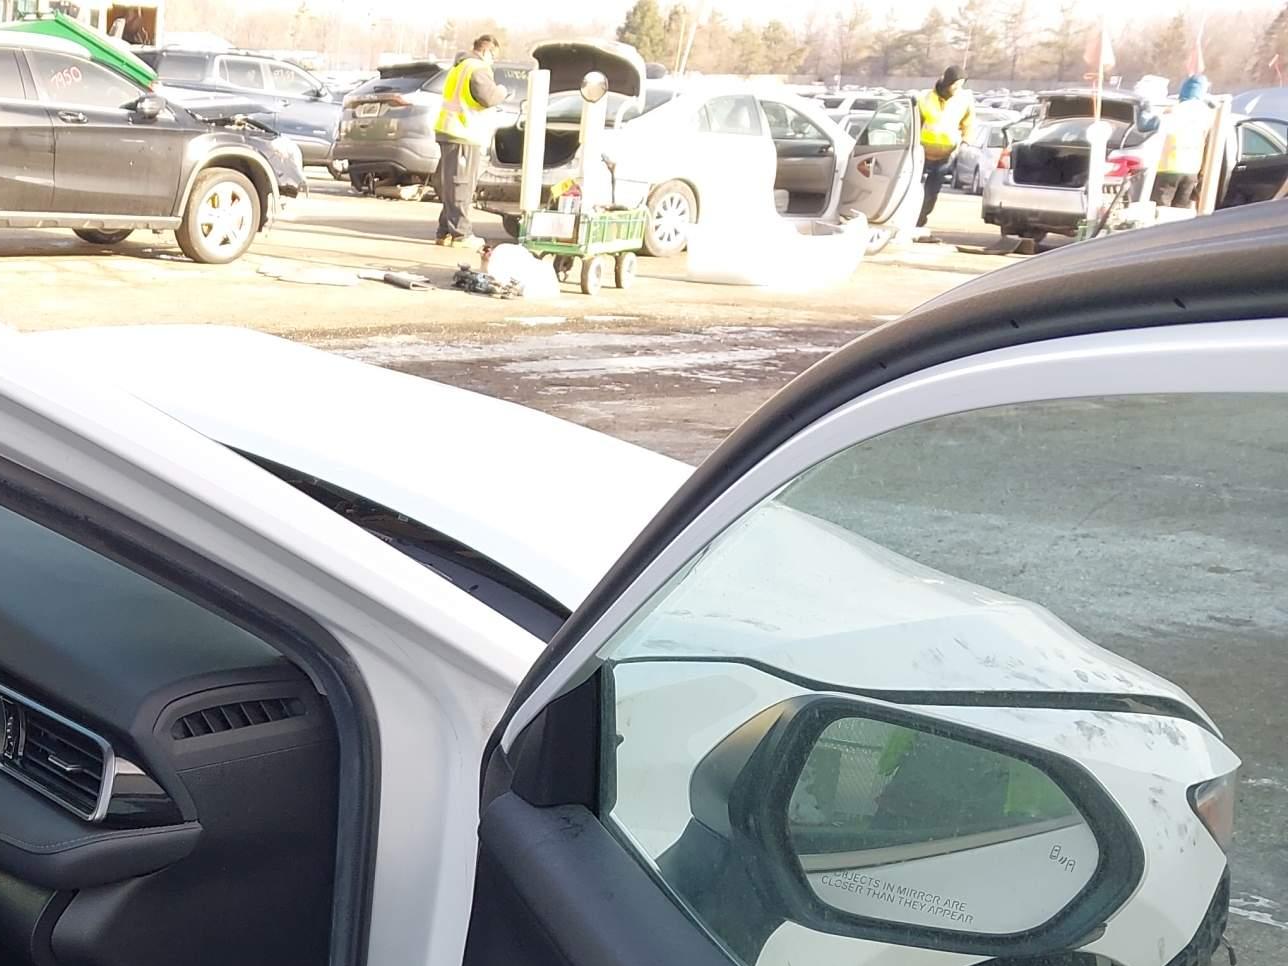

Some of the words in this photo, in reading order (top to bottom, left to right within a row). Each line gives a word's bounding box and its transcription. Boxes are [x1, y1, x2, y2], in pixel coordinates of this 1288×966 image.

[821, 875, 864, 895] CLOSER
[866, 887, 895, 904] THAN
[898, 896, 926, 912] THEY
[927, 905, 974, 924] APPEAR
[883, 882, 895, 893] IN
[896, 885, 941, 905] MIRROR
[943, 899, 968, 912] ARE
